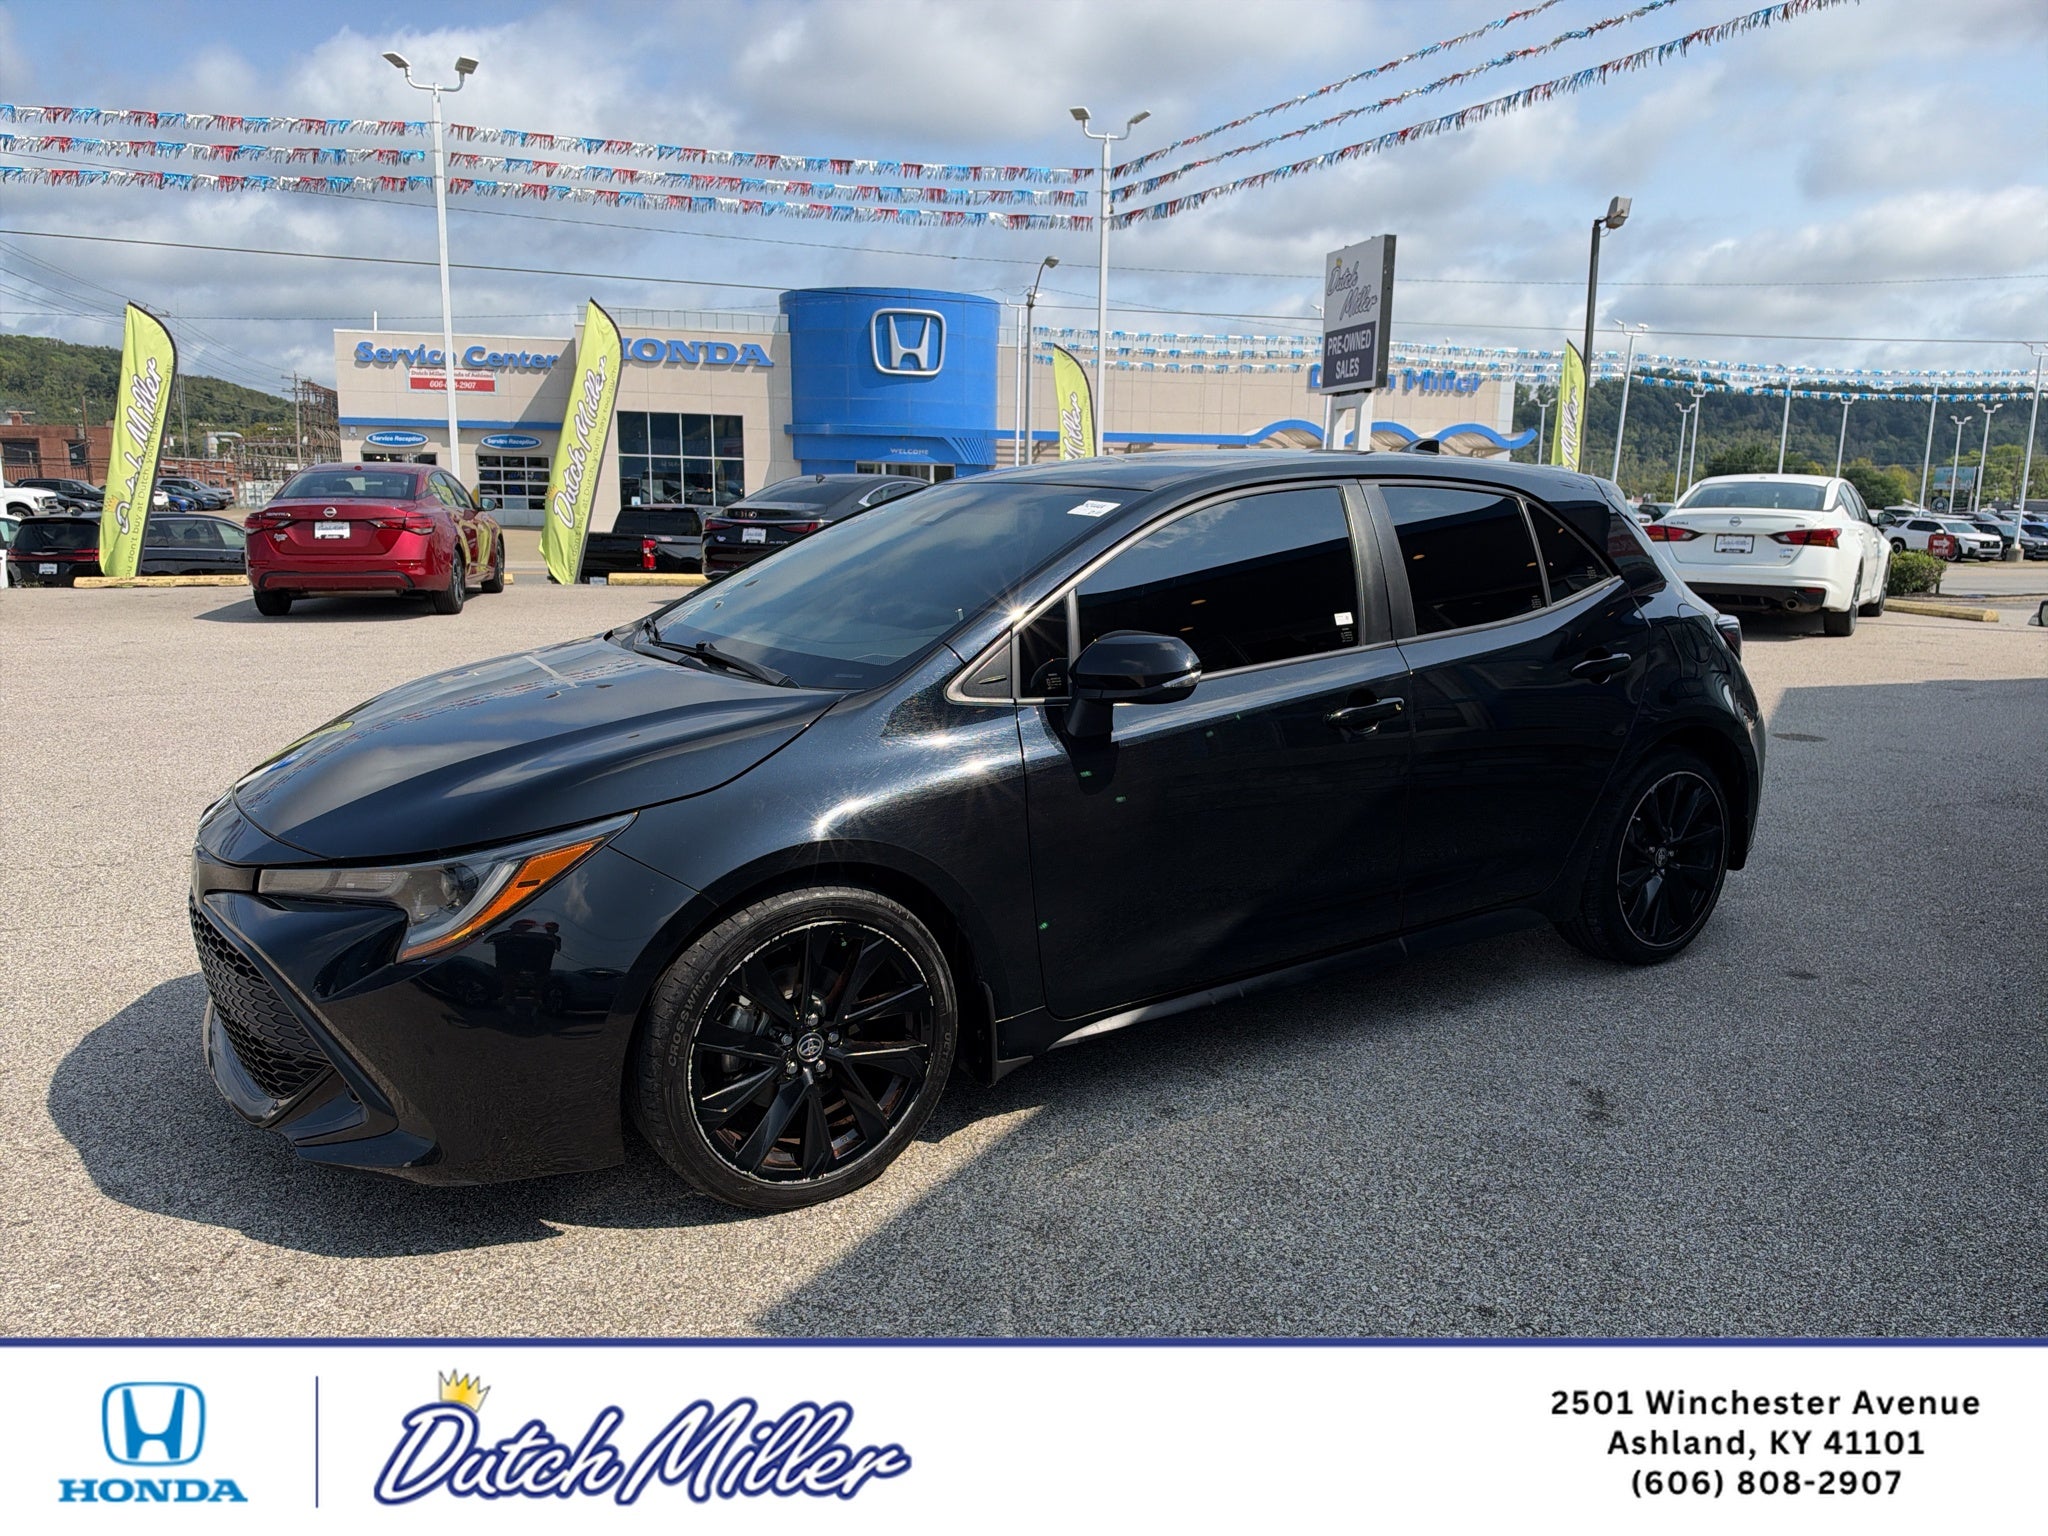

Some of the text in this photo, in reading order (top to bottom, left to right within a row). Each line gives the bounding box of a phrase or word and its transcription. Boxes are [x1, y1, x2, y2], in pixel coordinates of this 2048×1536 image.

[1326, 261, 1360, 297] Dutch
[1338, 284, 1378, 321] Miller
[1327, 328, 1372, 357] PRE-OWNED
[465, 345, 559, 369] Center
[1335, 357, 1360, 381] SALES
[429, 381, 477, 389] 606--2907
[126, 356, 162, 451] Miller
[394, 435, 423, 443] Reception
[1560, 385, 1579, 466] Miller
[553, 355, 607, 529] Dutch Miller
[890, 447, 929, 456] WELCOME
[141, 469, 151, 499] Dutch,
[137, 501, 144, 513] at
[133, 514, 143, 536] buy
[127, 537, 138, 563] don't
[668, 970, 711, 1068] CROSSWIND
